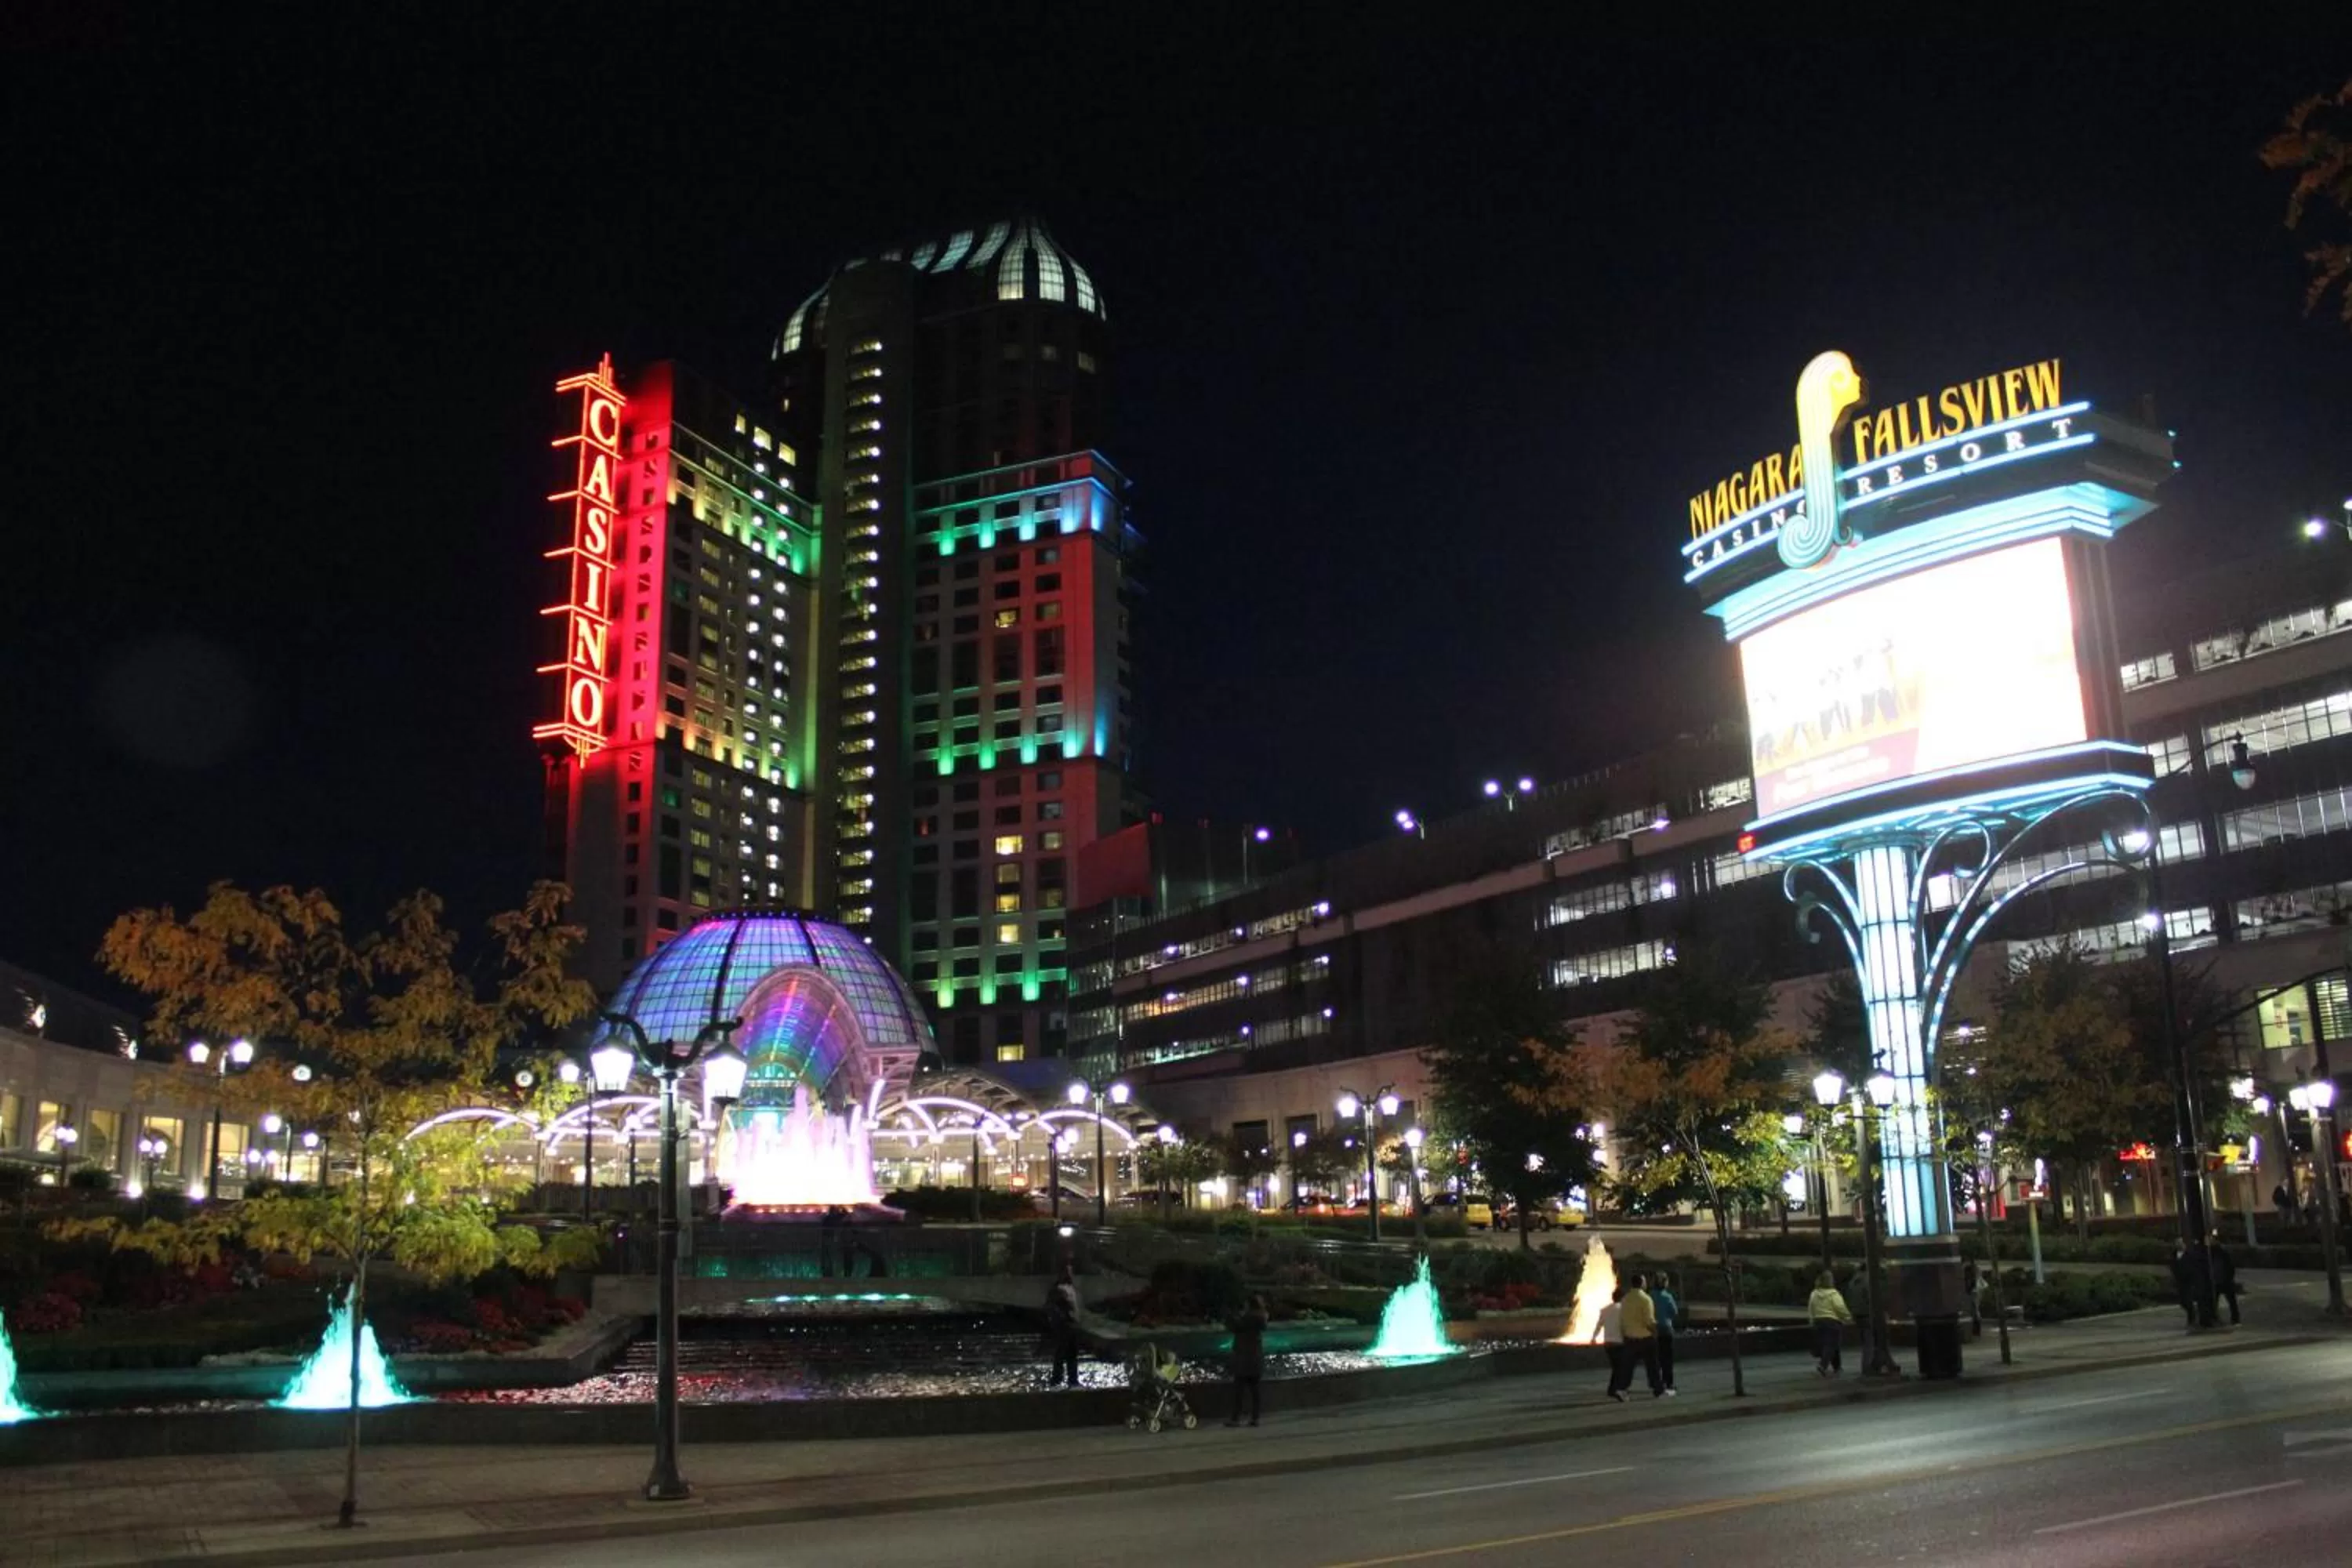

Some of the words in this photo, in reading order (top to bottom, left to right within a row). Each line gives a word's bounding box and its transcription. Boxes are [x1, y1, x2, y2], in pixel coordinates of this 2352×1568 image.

[1690, 443, 1804, 539] NIAGARA
[1853, 358, 2060, 465] FALLSVIEW
[1857, 419, 2073, 496] RESORT
[572, 398, 618, 727] CASINO
